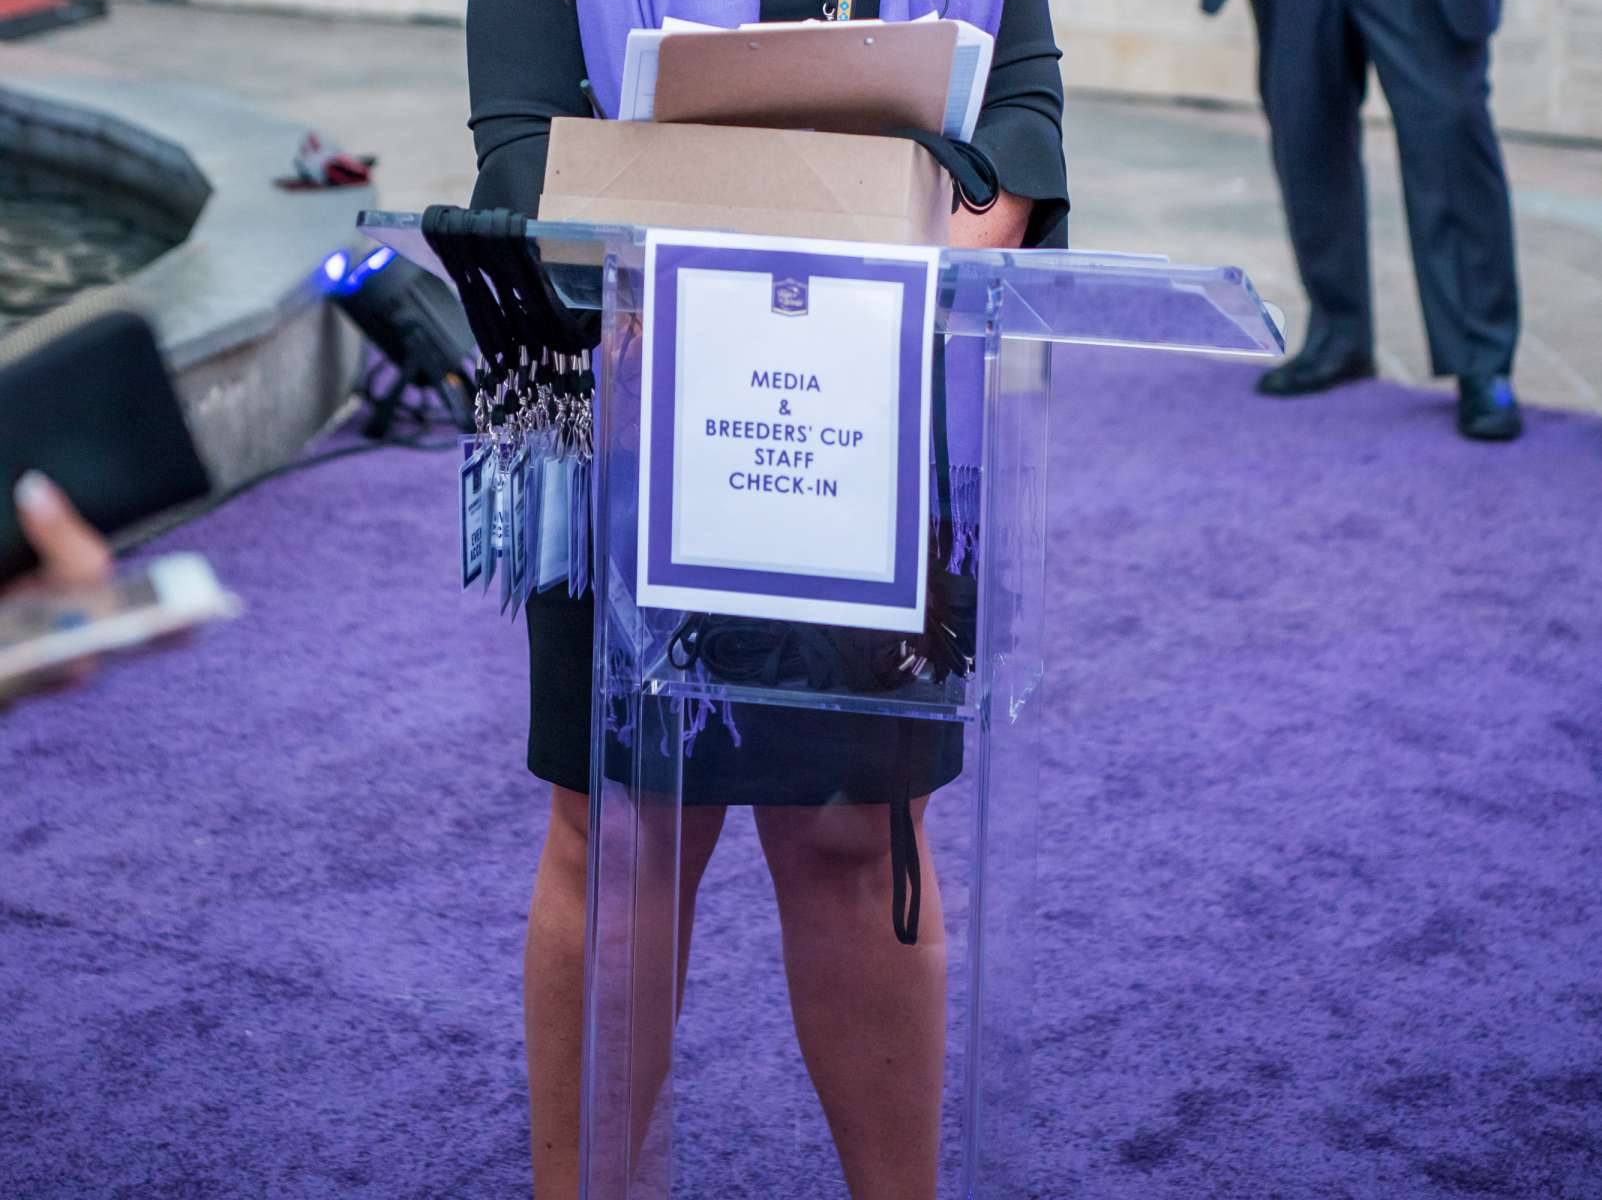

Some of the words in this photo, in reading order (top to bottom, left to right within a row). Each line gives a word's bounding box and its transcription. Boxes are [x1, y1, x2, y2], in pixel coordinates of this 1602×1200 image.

[750, 370, 821, 392] MEDIA
[778, 399, 792, 416] &
[705, 418, 813, 443] BREEDERS'
[820, 427, 864, 448] CUP
[754, 447, 814, 469] STAFF
[728, 471, 837, 497] CHECK-IN
